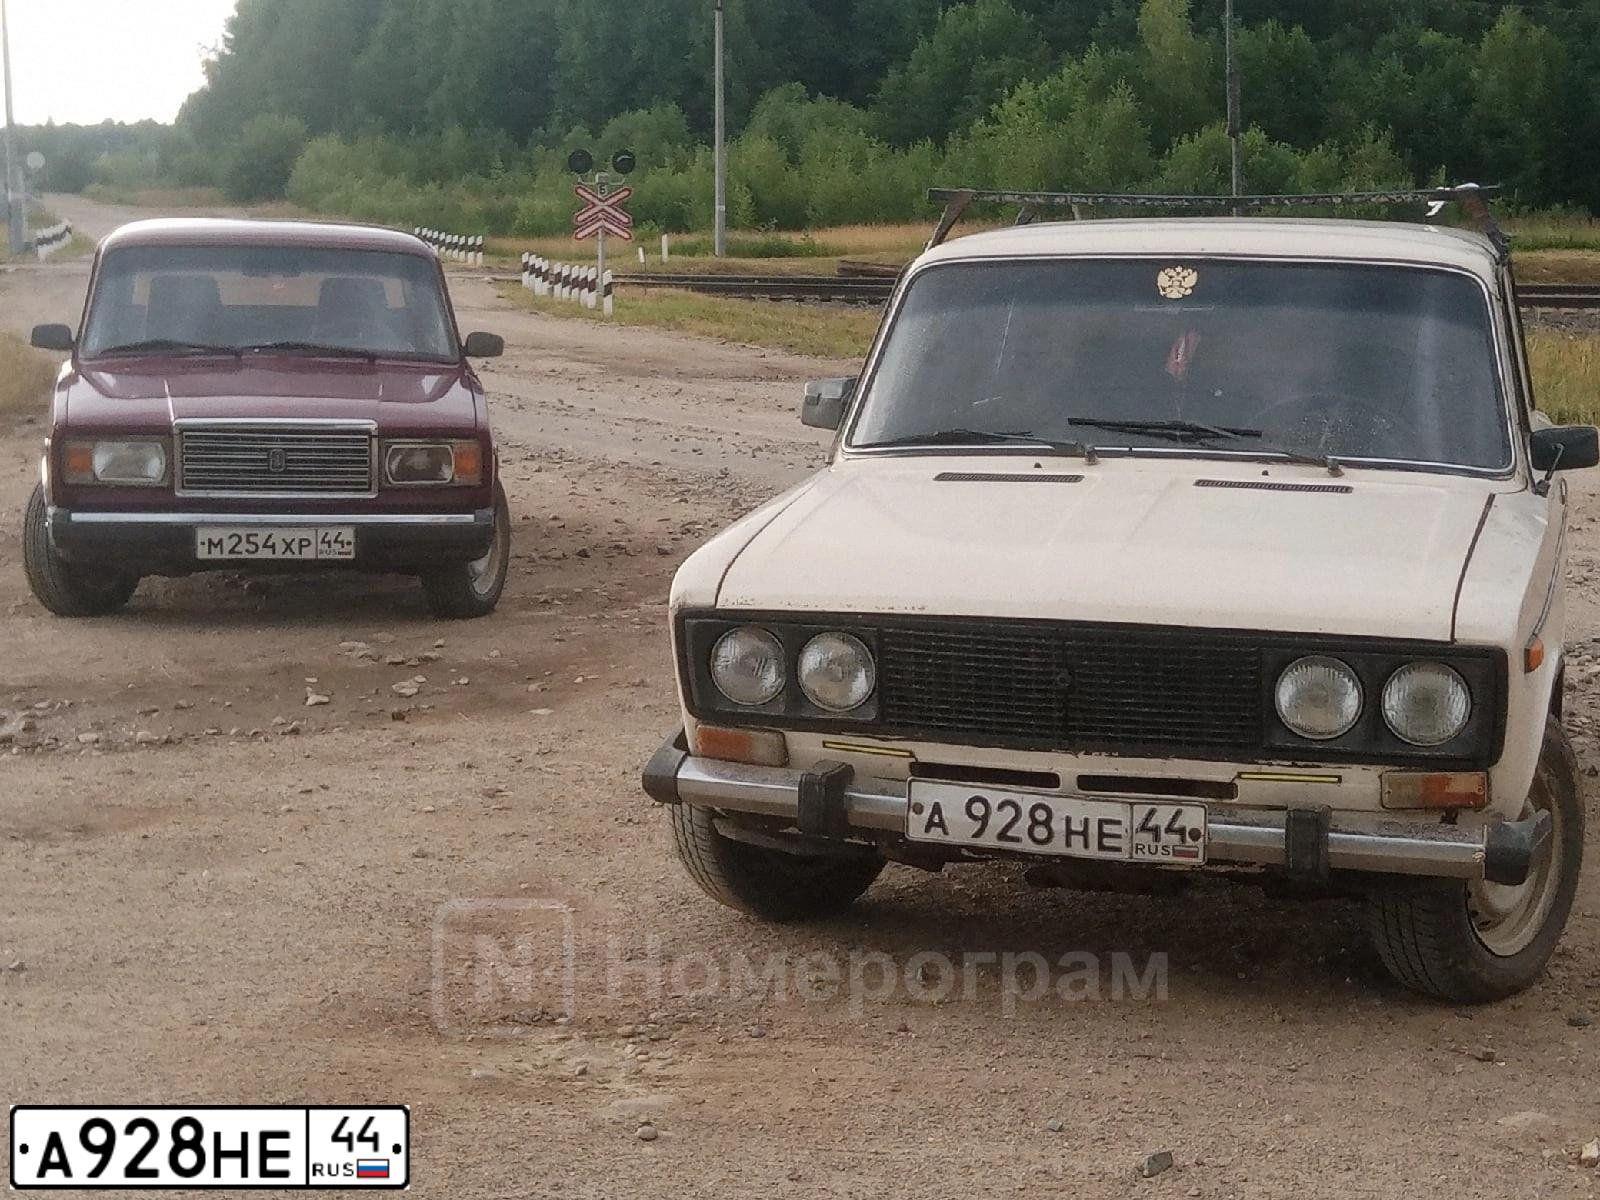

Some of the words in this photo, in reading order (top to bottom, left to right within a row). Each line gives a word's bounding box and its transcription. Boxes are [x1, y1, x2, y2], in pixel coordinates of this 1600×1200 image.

[208, 533, 311, 555] М254ХР
[320, 531, 345, 549] 44
[1135, 807, 1187, 844] 44
[1134, 843, 1171, 856] RUS
